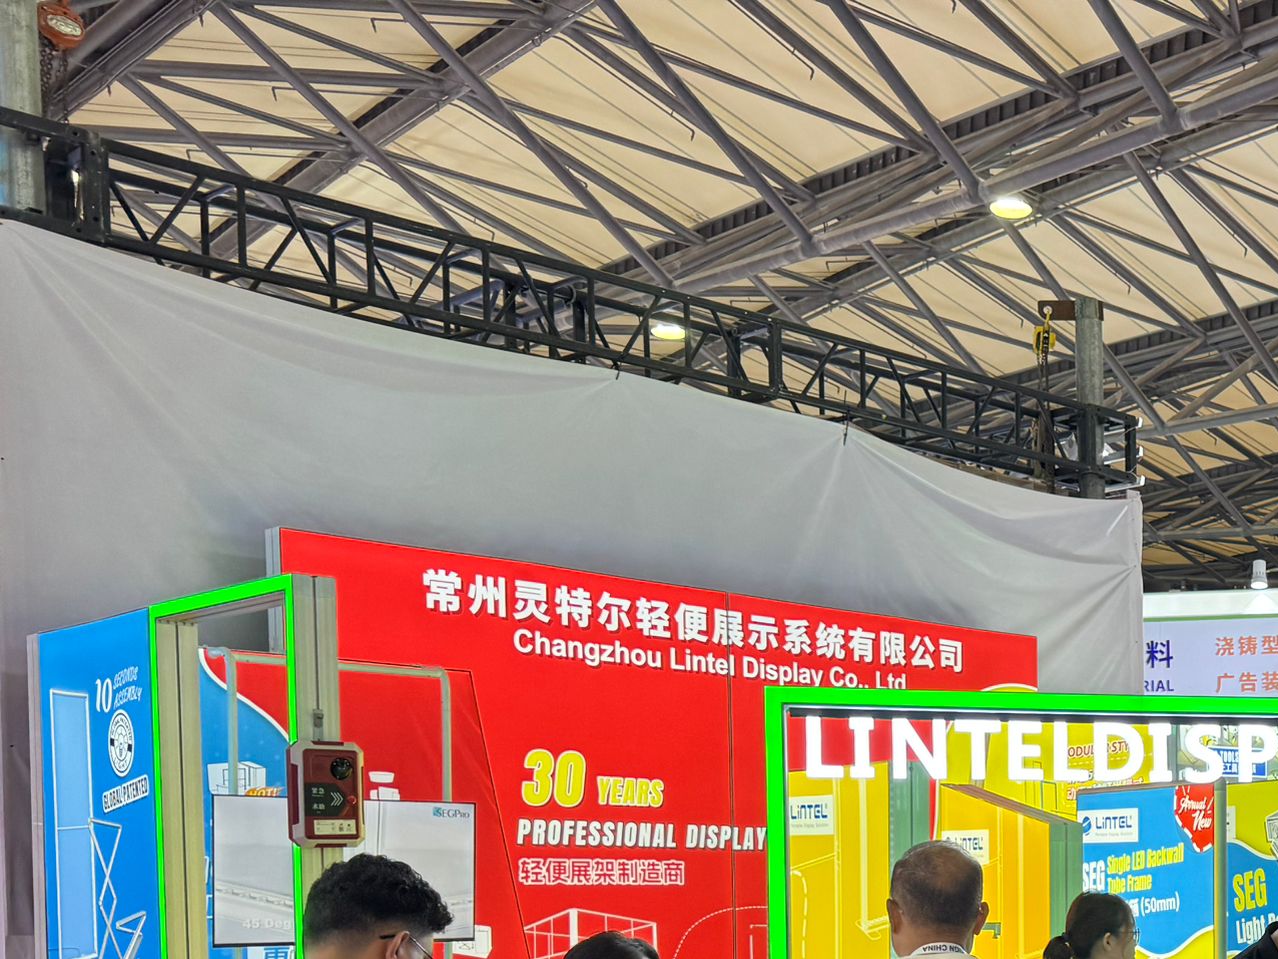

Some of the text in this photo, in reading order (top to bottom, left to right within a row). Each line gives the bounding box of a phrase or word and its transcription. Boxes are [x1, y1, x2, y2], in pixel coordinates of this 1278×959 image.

[423, 568, 963, 673] 常州灵特尔轻便展示系统有限公司
[513, 628, 661, 668] Changzhou
[670, 647, 735, 676] Lintel
[743, 656, 823, 687] Display
[1146, 640, 1173, 669] 料
[113, 665, 139, 688] SECONDS
[95, 677, 113, 713] 10
[522, 748, 664, 807] 30 YEARS
[517, 818, 768, 850] PROFESSIONAL DISPLAY
[518, 858, 685, 886] 轻便展架制造商
[1082, 842, 1184, 893] SEG Single LED Backwall
[1127, 874, 1152, 892] Frame
[1232, 868, 1268, 912] SEG
[1141, 891, 1180, 916] (50mm)
[1236, 915, 1266, 944] Light
[922, 944, 948, 952] CHINA
